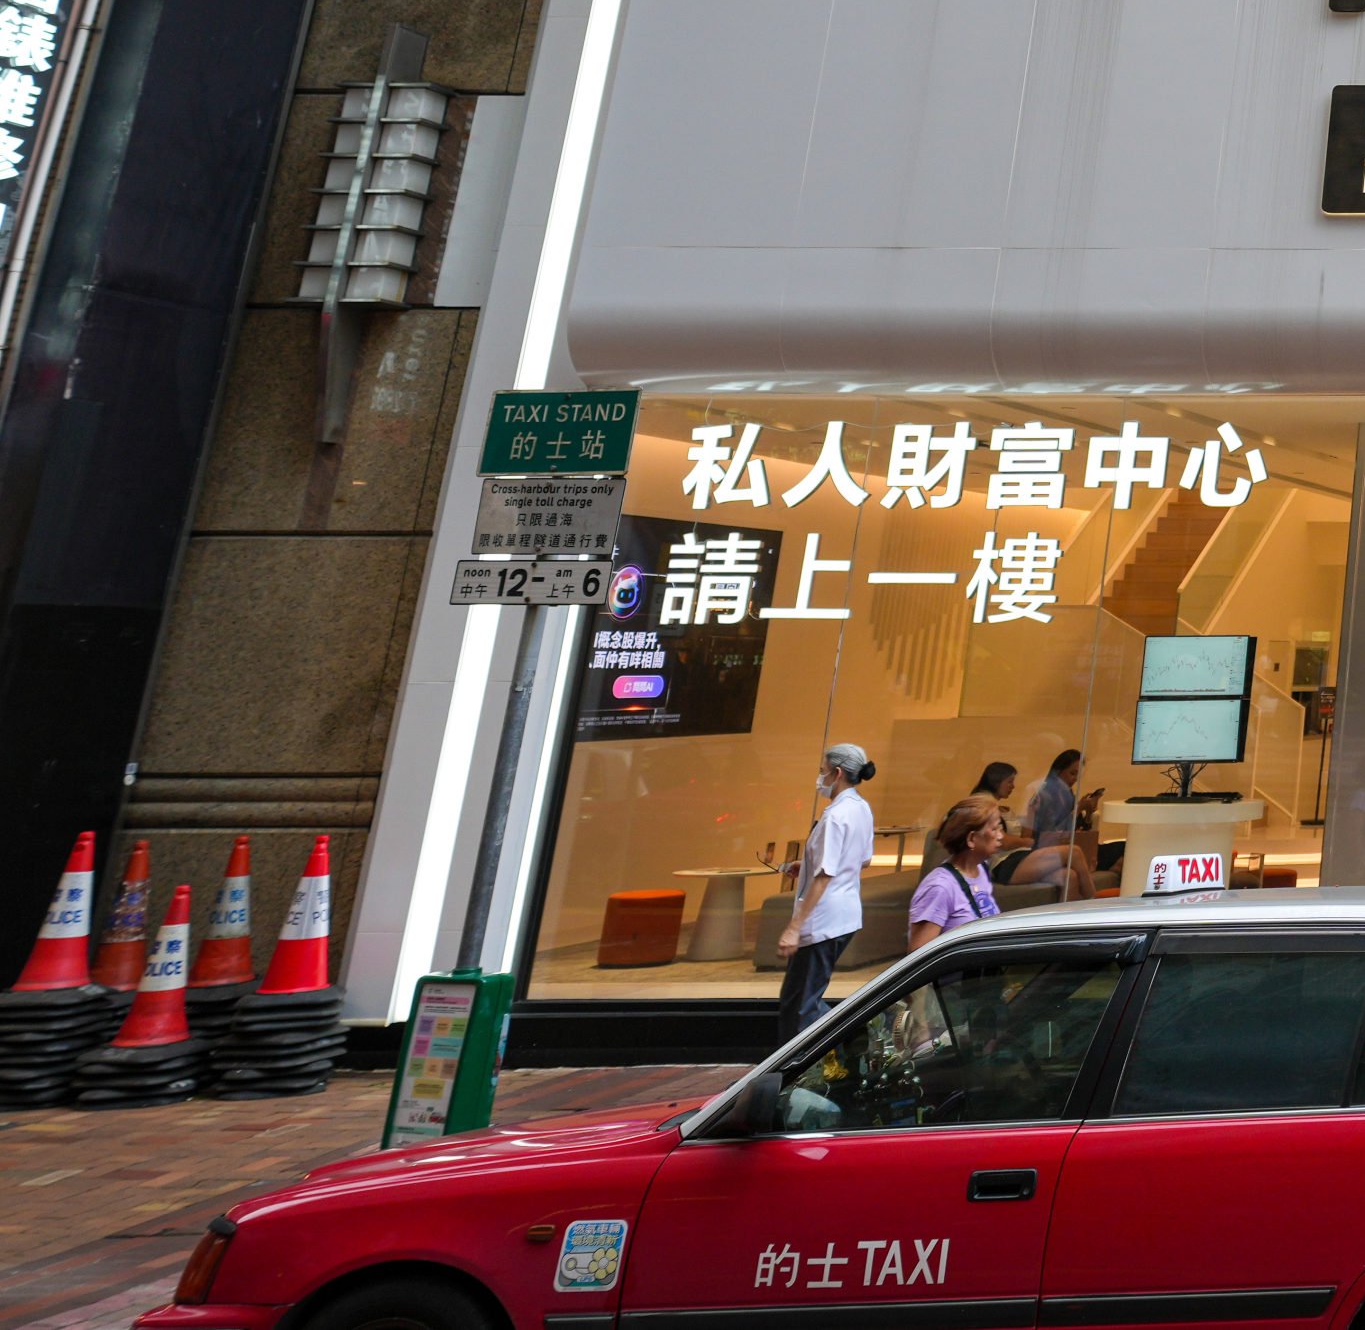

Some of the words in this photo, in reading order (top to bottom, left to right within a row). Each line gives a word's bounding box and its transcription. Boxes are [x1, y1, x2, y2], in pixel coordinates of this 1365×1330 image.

[503, 405, 548, 422] TAXI
[556, 403, 626, 422] STAND
[509, 429, 606, 460] 的士站
[682, 420, 1271, 512] 私人財富中心
[491, 483, 560, 494] Cross-harbour
[563, 483, 588, 496] trips
[590, 483, 614, 496] only
[504, 497, 532, 508] single
[535, 497, 554, 507] toll
[557, 497, 592, 508] charge
[515, 513, 573, 527] 只限過海
[463, 569, 490, 578] noon
[555, 569, 572, 578] am
[582, 568, 601, 597] 6
[658, 531, 1062, 627] 請上一樓
[460, 584, 487, 599] 中午
[546, 584, 575, 599] 上午
[1153, 863, 1167, 885] 的士
[1177, 857, 1219, 884] TAXI
[753, 1243, 845, 1288] 的士
[857, 1238, 950, 1285] TAXI
